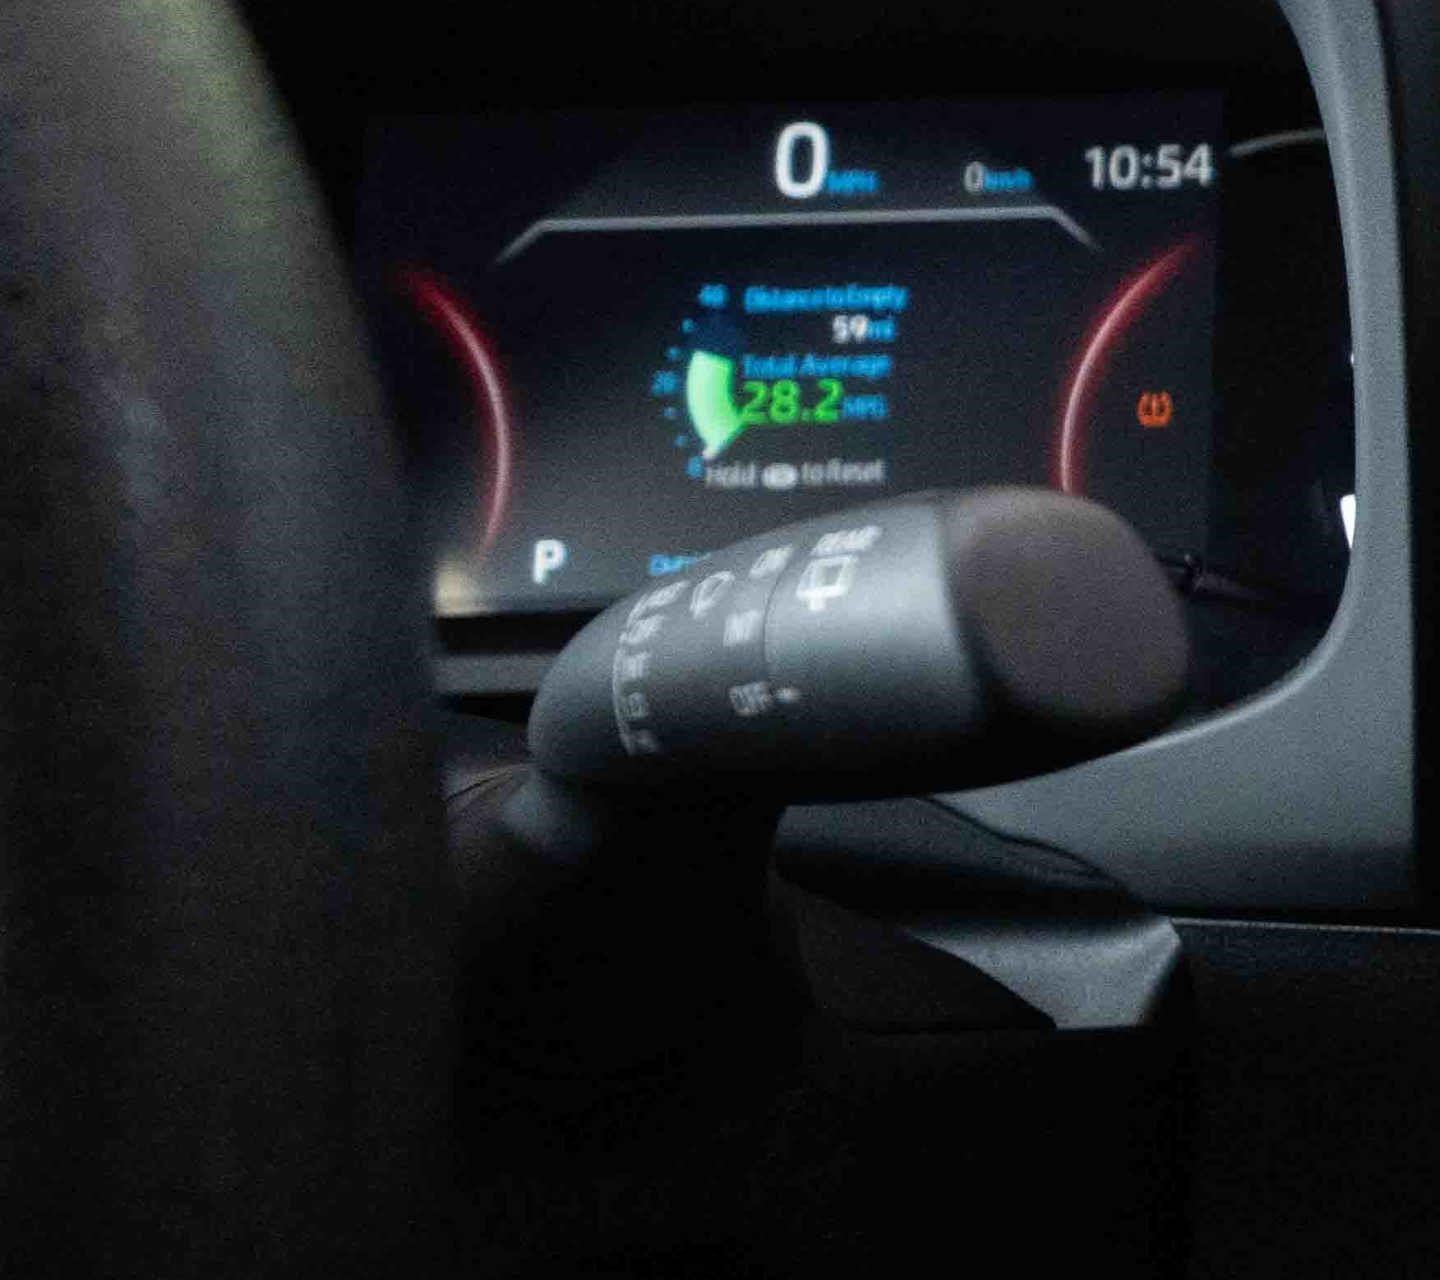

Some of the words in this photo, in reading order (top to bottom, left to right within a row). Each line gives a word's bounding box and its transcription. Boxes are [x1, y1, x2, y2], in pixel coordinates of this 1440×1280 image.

[775, 120, 827, 197] 0
[1084, 142, 1214, 190] 10:54
[963, 160, 984, 194] 0
[743, 285, 824, 312] Distance
[846, 283, 908, 311] Empty
[831, 314, 868, 344] 59
[742, 354, 797, 379] Total
[799, 352, 892, 381] Average
[740, 379, 843, 424] 28.2
[705, 462, 757, 489] Hold
[824, 458, 886, 487] Reset
[533, 538, 570, 586] P
